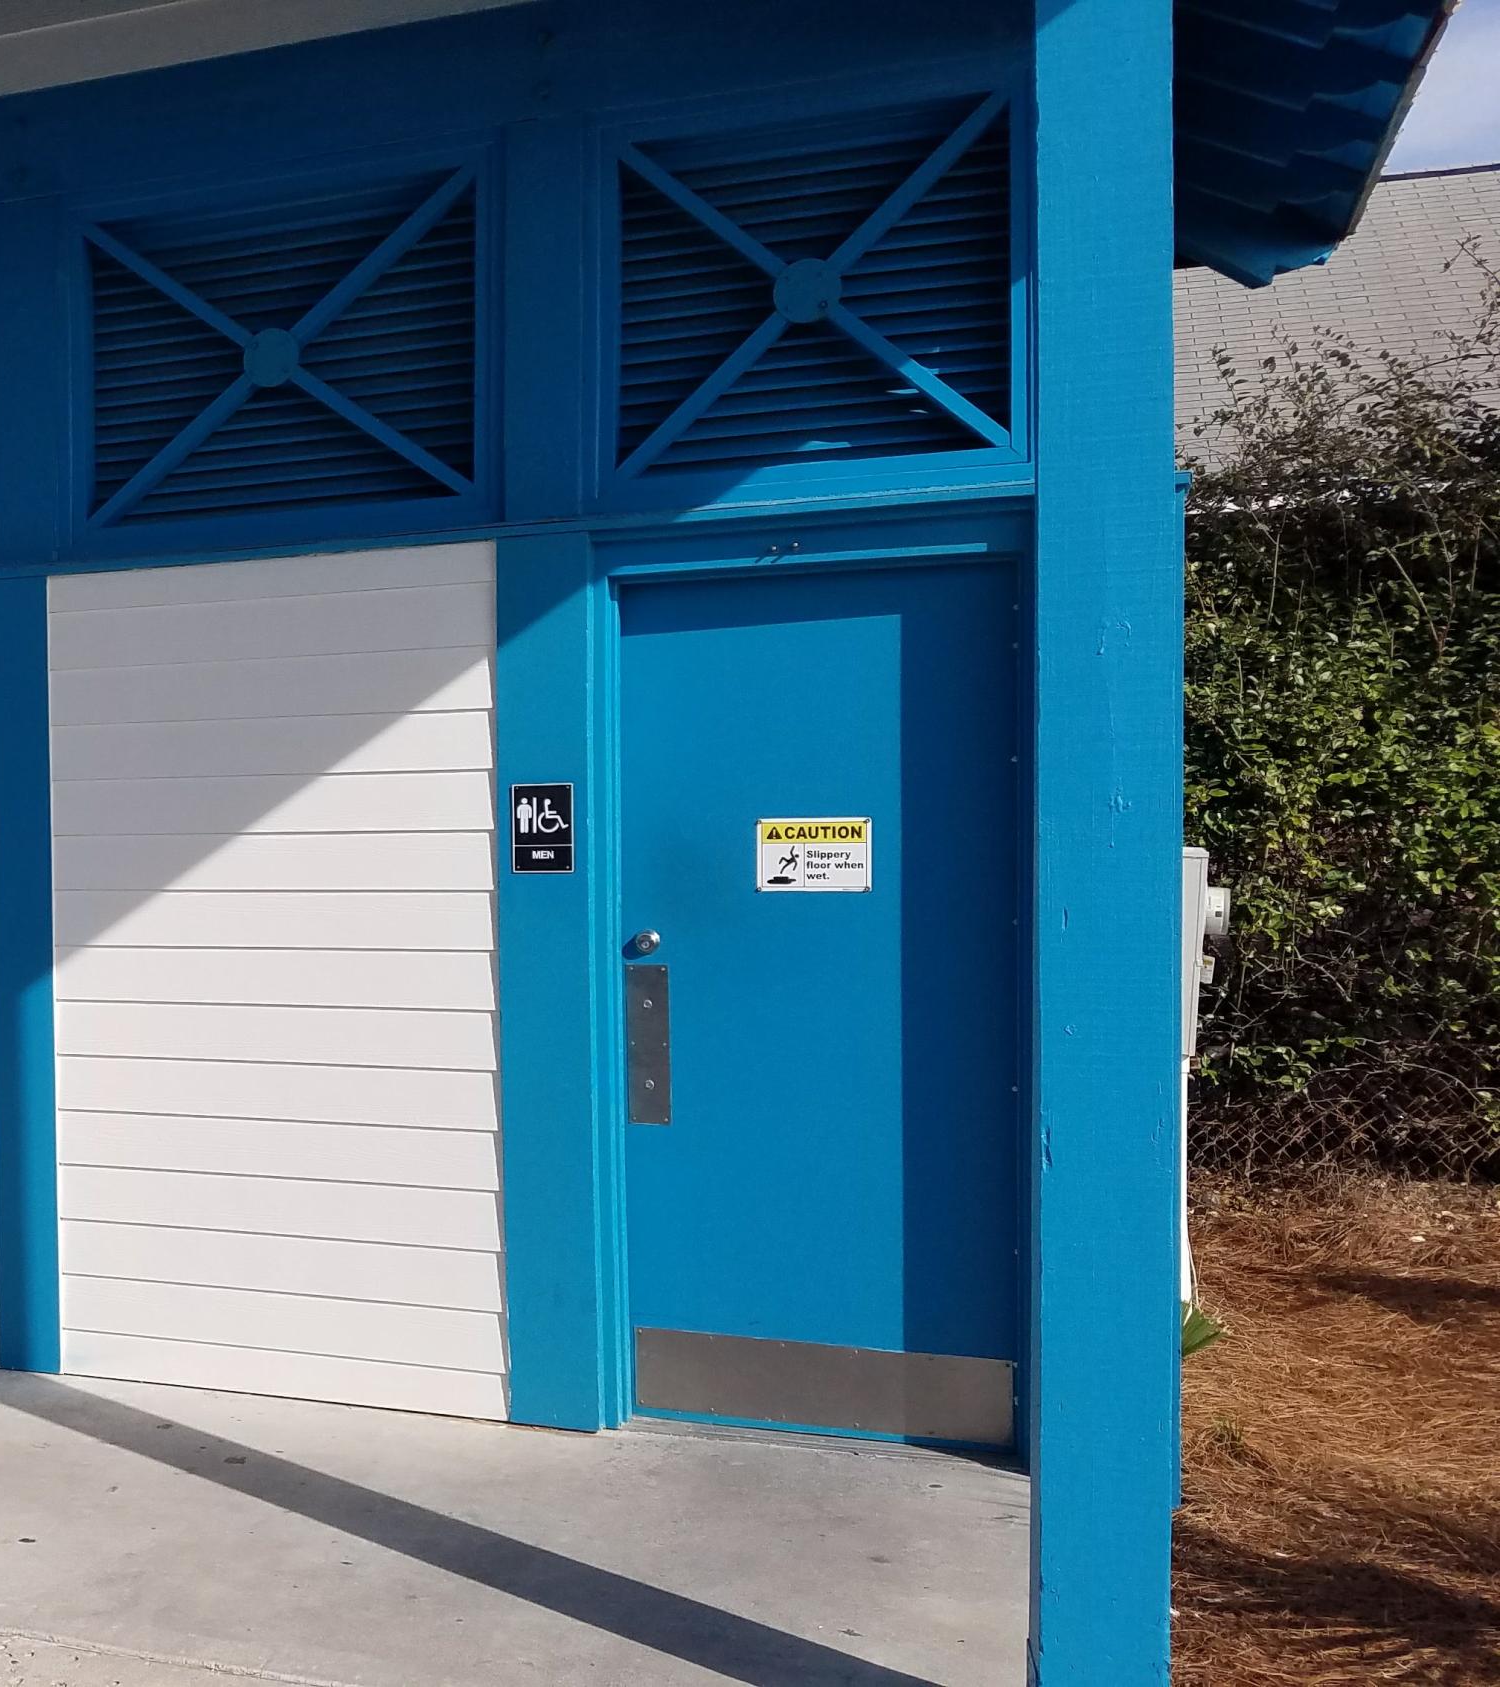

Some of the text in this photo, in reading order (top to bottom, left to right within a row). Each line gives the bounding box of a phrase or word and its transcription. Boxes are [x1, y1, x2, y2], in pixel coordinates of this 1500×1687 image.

[784, 825, 863, 839] CAUTION
[532, 850, 555, 859] MEN
[806, 850, 851, 860] Slippery
[806, 861, 864, 869] floor when
